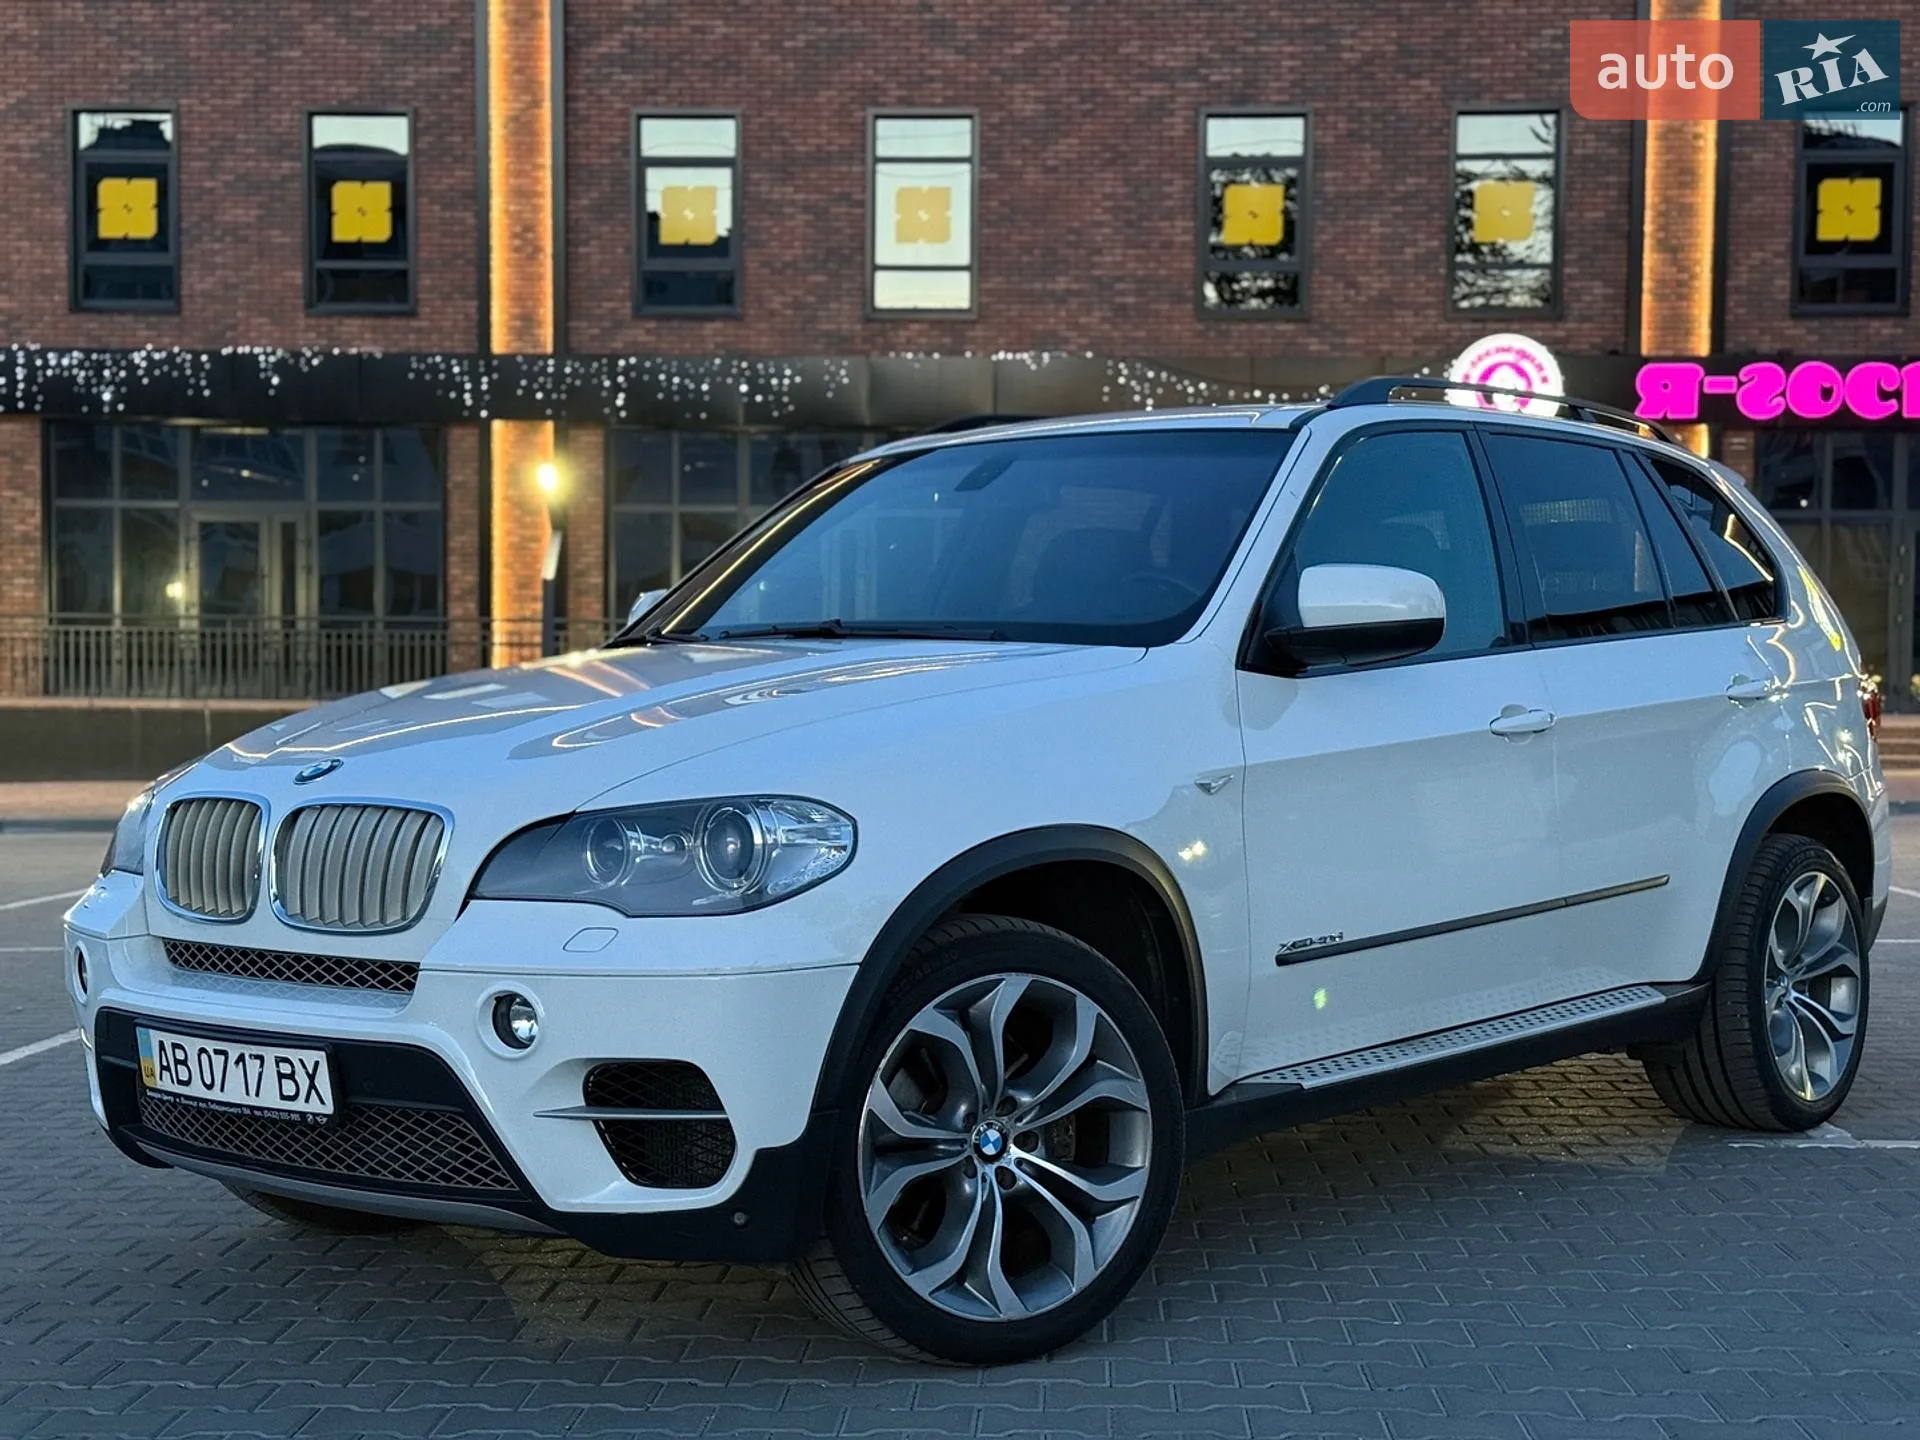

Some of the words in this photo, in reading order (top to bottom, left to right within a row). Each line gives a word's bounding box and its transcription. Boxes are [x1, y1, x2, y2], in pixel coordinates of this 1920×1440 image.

[158, 1040, 193, 1087] AB
[197, 1046, 265, 1098] 0717
[274, 1055, 326, 1105] BX
